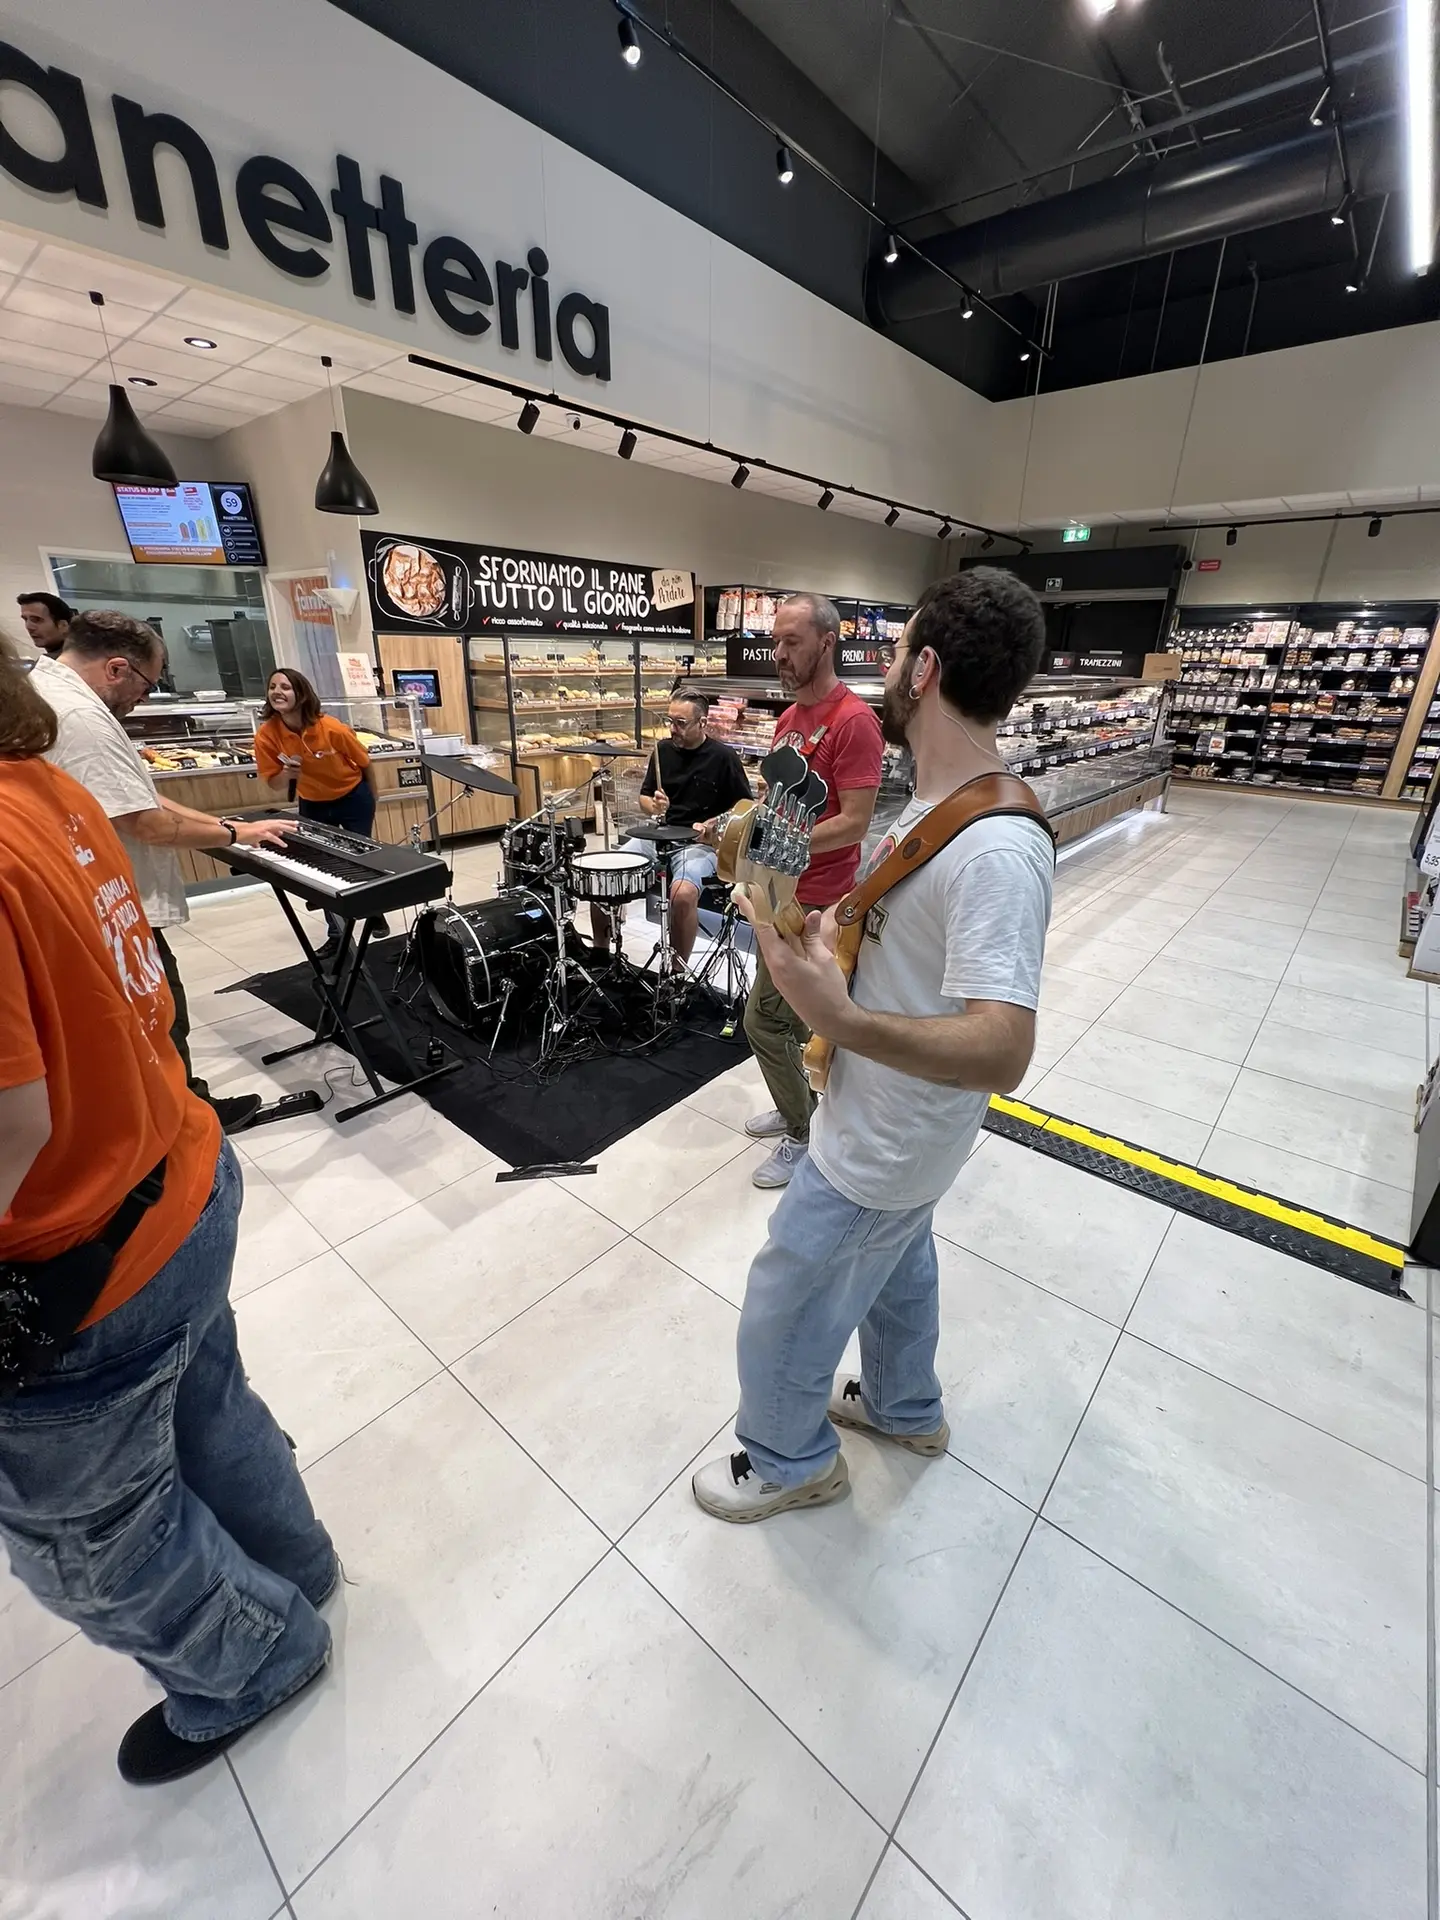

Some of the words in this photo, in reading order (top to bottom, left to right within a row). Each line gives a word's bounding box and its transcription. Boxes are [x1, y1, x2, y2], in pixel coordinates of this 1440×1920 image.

[0, 40, 611, 381] anetteria
[225, 497, 238, 508] 59
[479, 555, 585, 588] SFORNIAMO
[591, 567, 605, 591] IL
[609, 570, 646, 594] PANE
[473, 580, 555, 611] TUTTO
[562, 587, 578, 613] IL
[584, 590, 651, 618] GIORNO
[491, 616, 506, 625] ricco
[506, 616, 544, 627] assortimento
[841, 649, 865, 662] PRENDI
[1079, 658, 1123, 668] TRAMEZZINI
